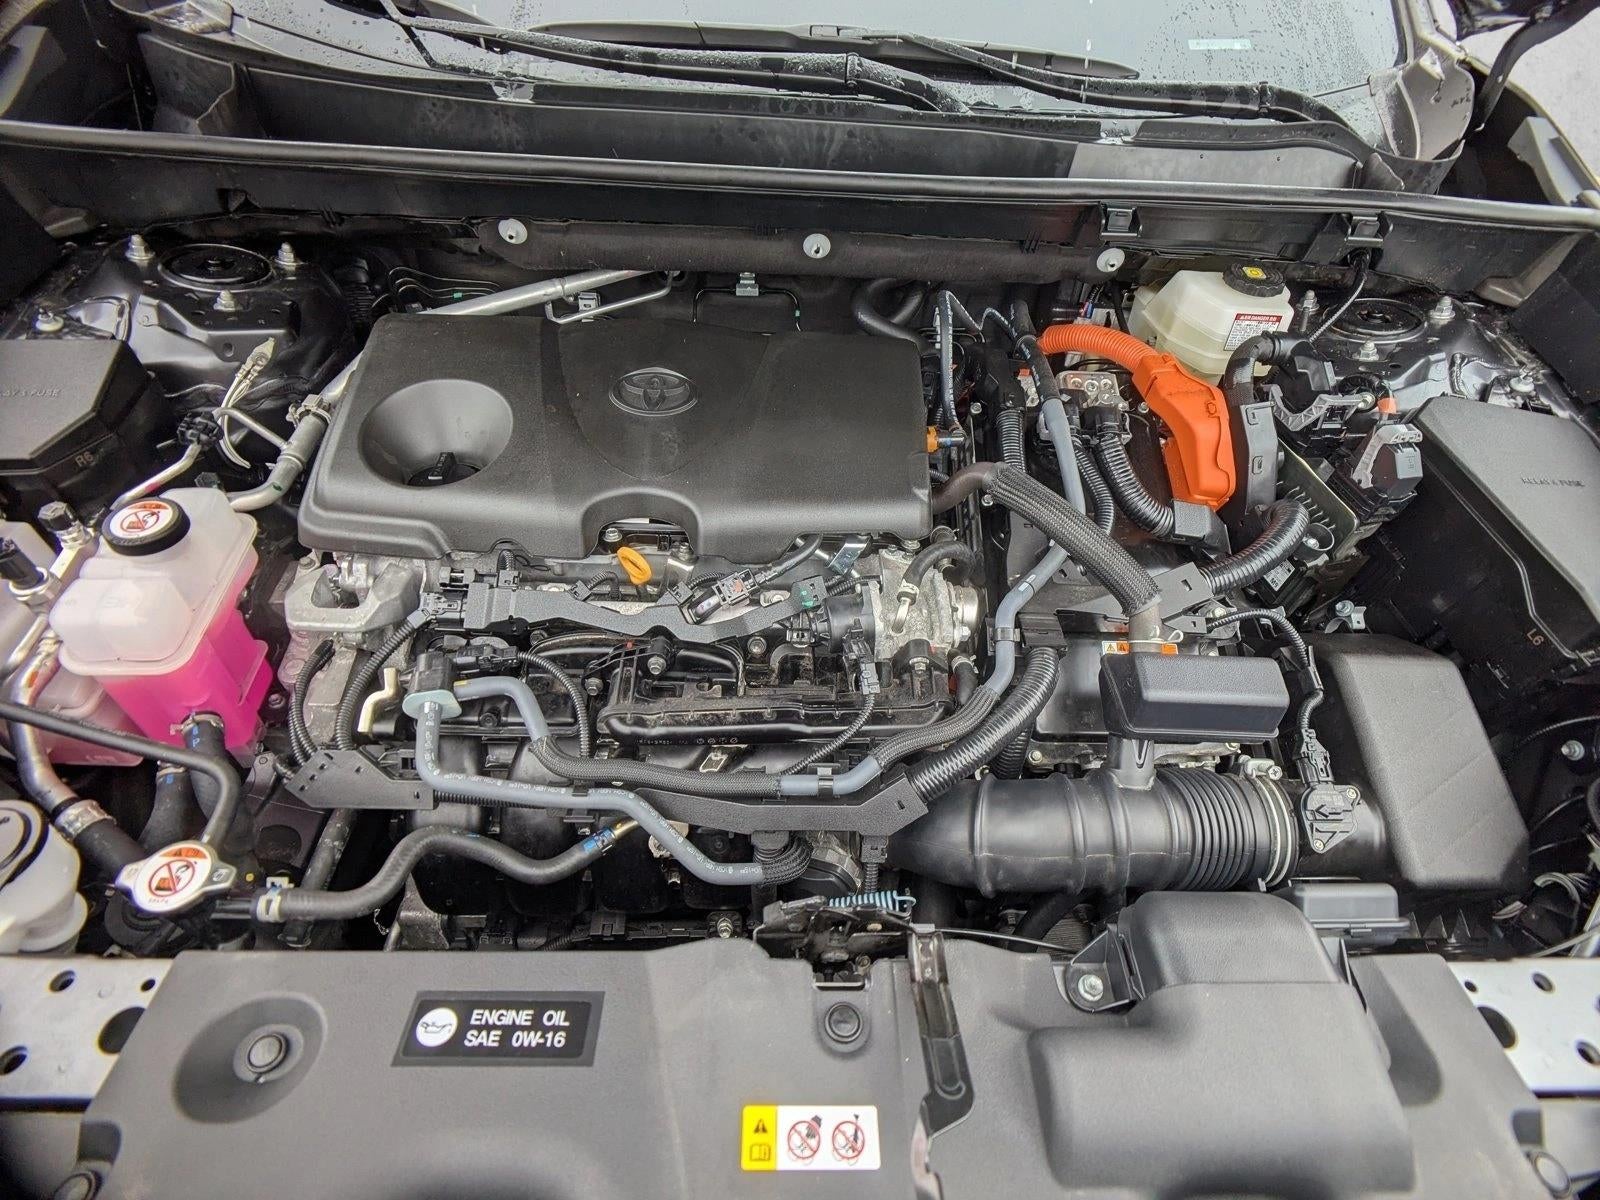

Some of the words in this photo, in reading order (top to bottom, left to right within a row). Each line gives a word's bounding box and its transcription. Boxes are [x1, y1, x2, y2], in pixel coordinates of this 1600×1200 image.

[75, 451, 95, 467] R6
[1527, 629, 1544, 645] L6
[470, 1009, 534, 1026] ENGINE
[542, 1009, 570, 1026] OIL
[464, 1029, 502, 1047] SAE
[511, 1030, 567, 1048] 0W-16
